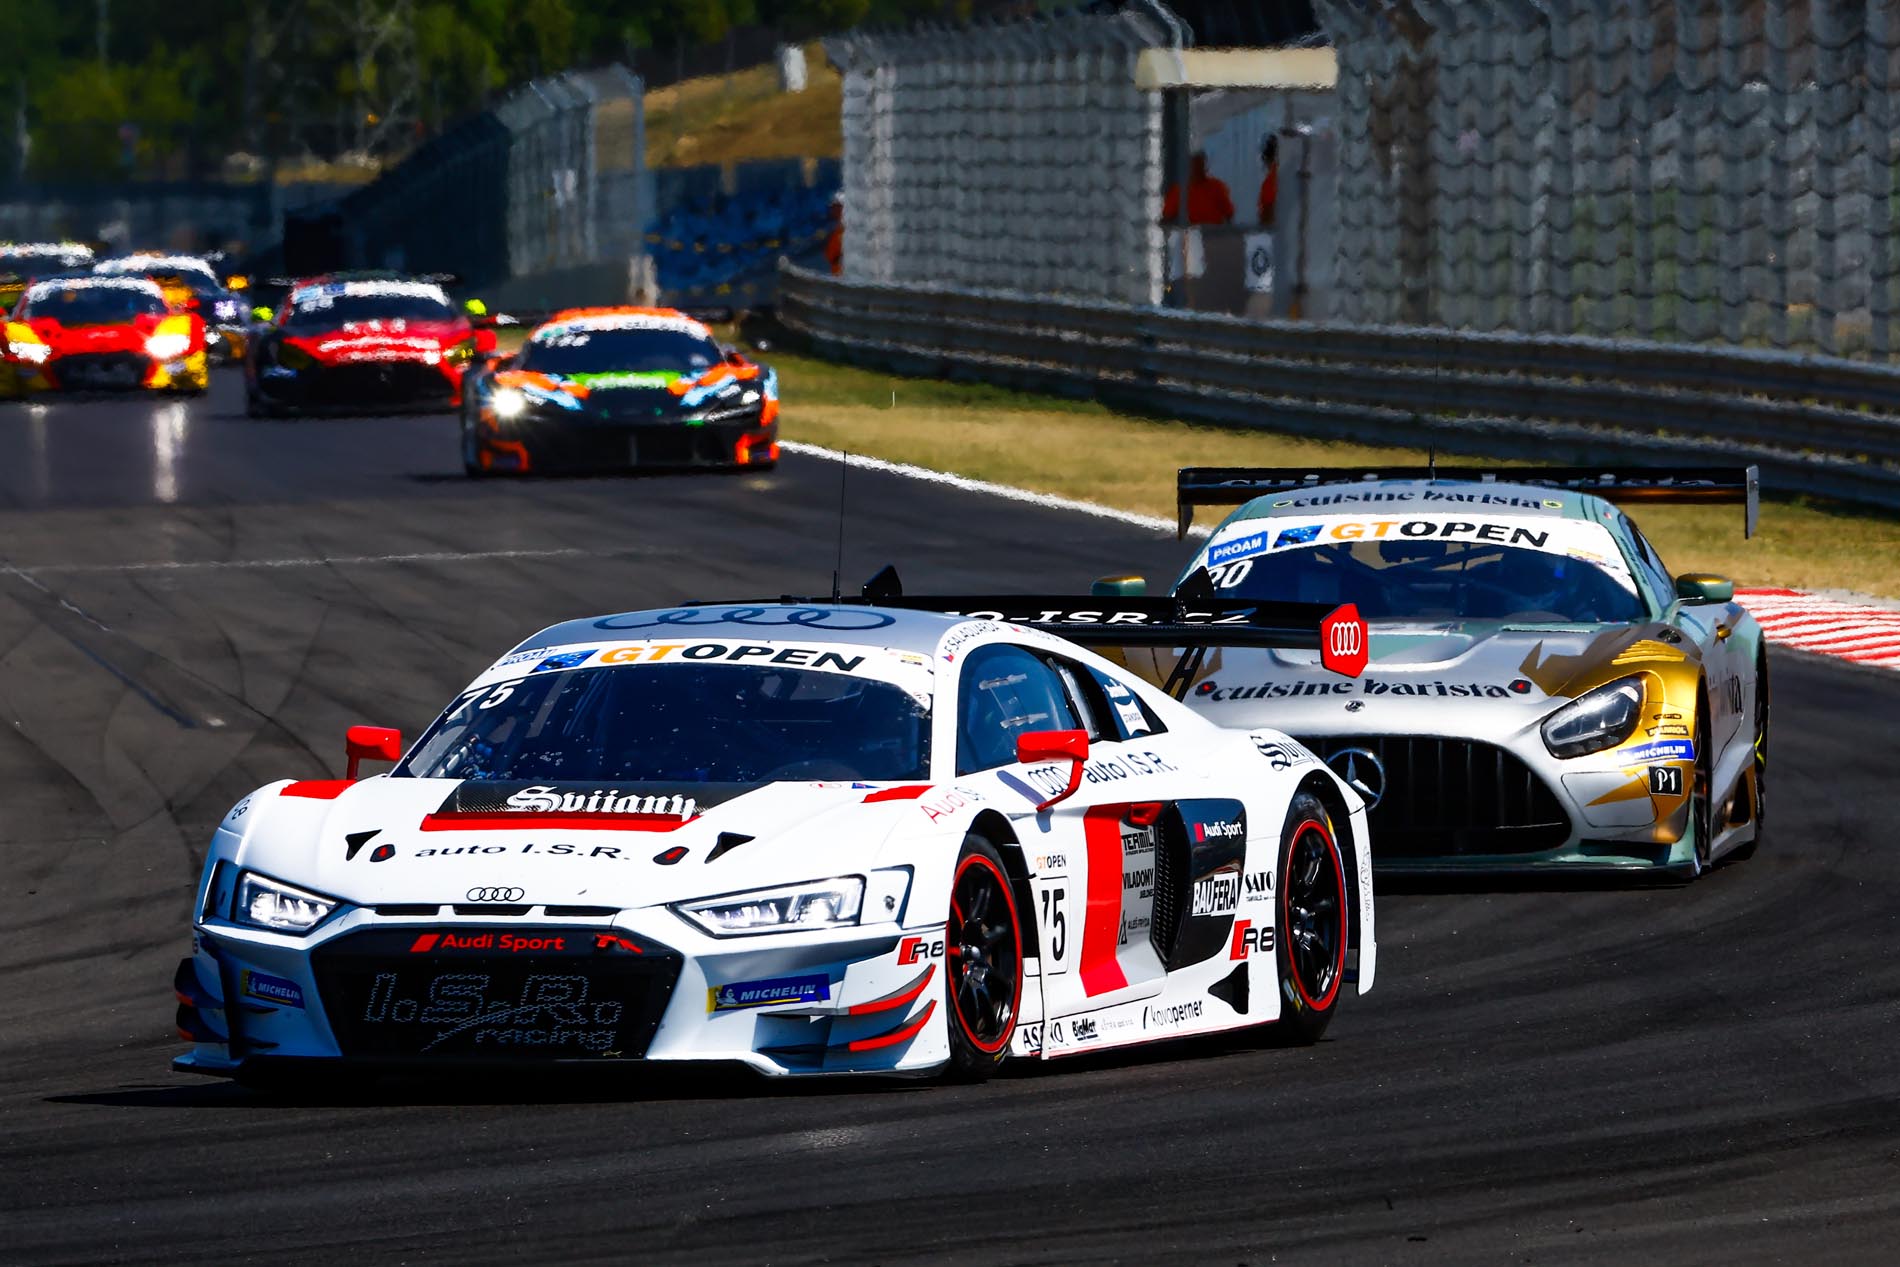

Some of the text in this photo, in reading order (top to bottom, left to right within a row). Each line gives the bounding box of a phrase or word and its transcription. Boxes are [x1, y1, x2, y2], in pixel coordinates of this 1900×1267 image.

[1213, 536, 1263, 561] PROAM
[502, 648, 556, 666] PROAM
[1210, 678, 1511, 701] cuisine barista
[447, 679, 526, 722] 75
[1634, 745, 1686, 759] MICHELIN
[1083, 760, 1127, 784] auto
[1203, 820, 1243, 839] Audi Sport
[415, 843, 631, 860] auto I.S.R.
[1122, 868, 1155, 890] VILADOMY
[1245, 871, 1276, 894] SATO
[1192, 877, 1237, 915] BAUFERA
[440, 934, 566, 951] Audi Sport
[910, 940, 944, 961] R8
[1241, 926, 1275, 954] R8
[257, 982, 301, 1000] MICHELIN
[740, 984, 816, 1001] MICHELIN
